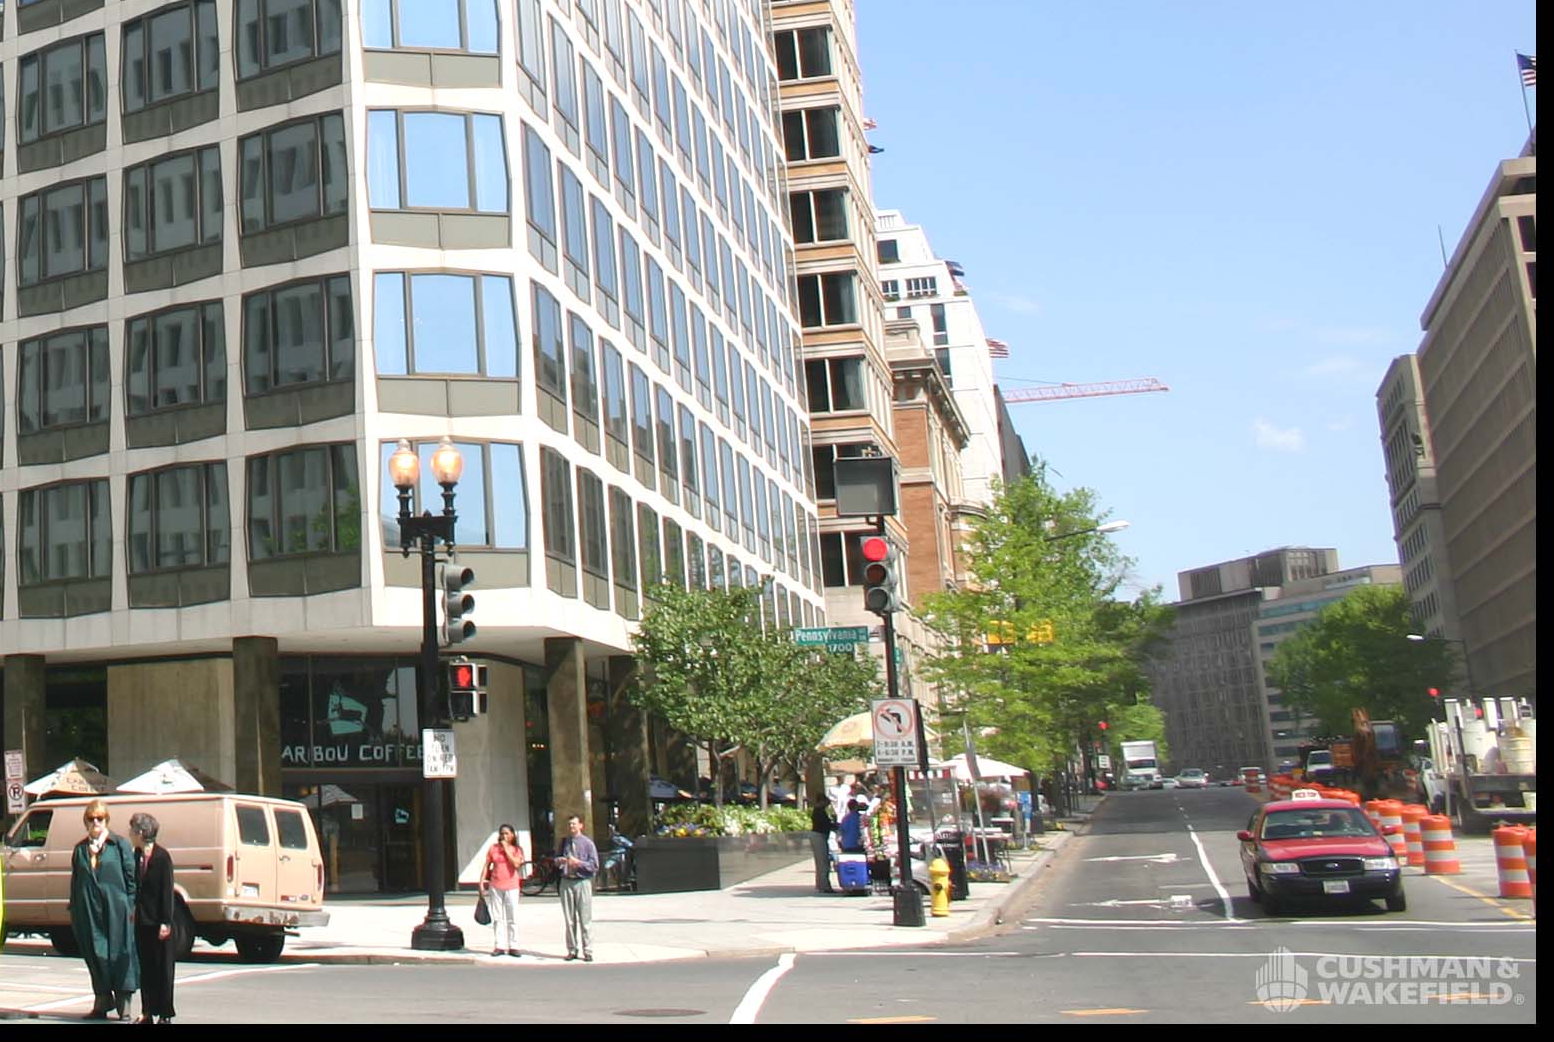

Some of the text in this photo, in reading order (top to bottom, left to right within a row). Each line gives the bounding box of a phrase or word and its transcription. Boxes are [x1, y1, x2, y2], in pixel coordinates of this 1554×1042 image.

[795, 629, 857, 642] Pennsylvania
[828, 642, 853, 652] 1700
[433, 733, 445, 742] NO
